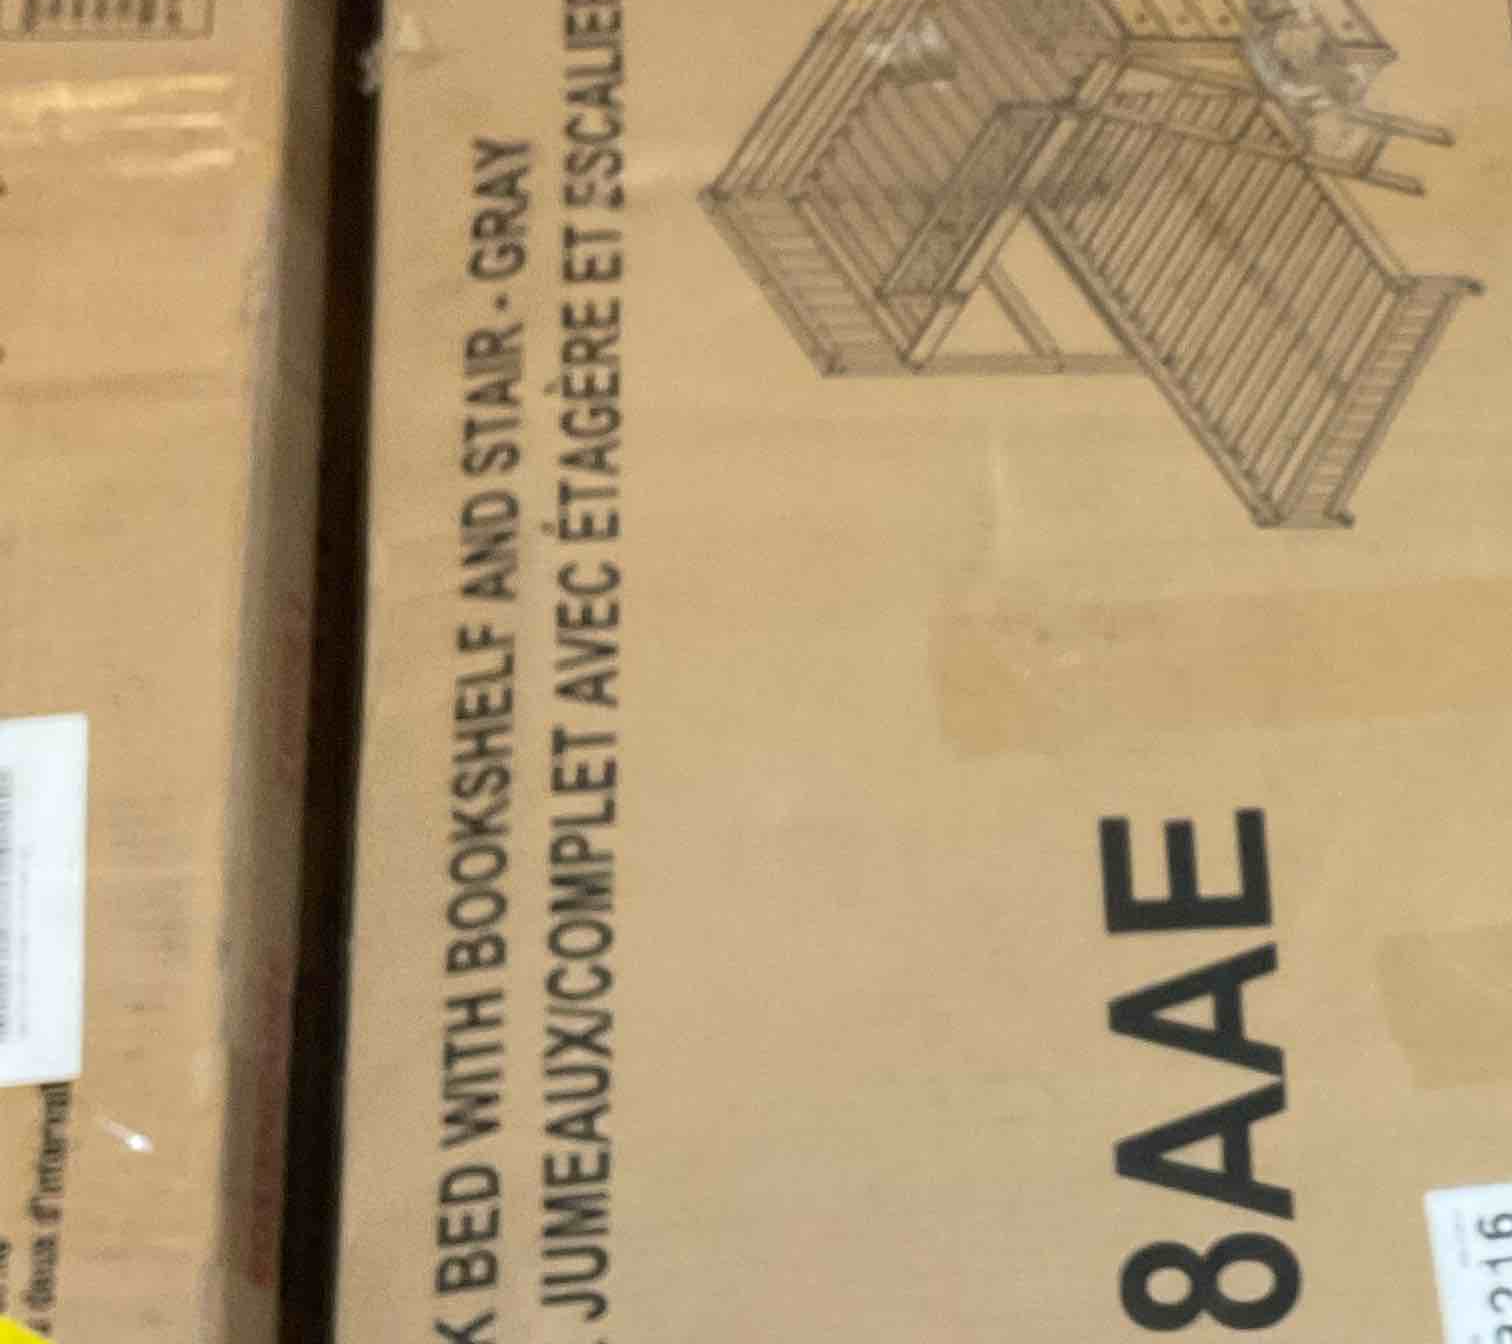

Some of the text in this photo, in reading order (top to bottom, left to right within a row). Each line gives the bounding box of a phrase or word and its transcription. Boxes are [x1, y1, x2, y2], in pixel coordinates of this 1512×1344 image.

[467, 138, 531, 282] GRAY
[561, 225, 623, 285] ET
[459, 322, 524, 477] STAIR
[540, 298, 623, 544] ÉTAGÈRE
[459, 490, 520, 602] AND
[554, 561, 622, 709] AVEC
[444, 624, 516, 975] BOOKSHELF
[440, 989, 505, 1149] WITH
[539, 727, 619, 1323] JUMEAUX/COMPLET
[434, 1164, 501, 1296] BED
